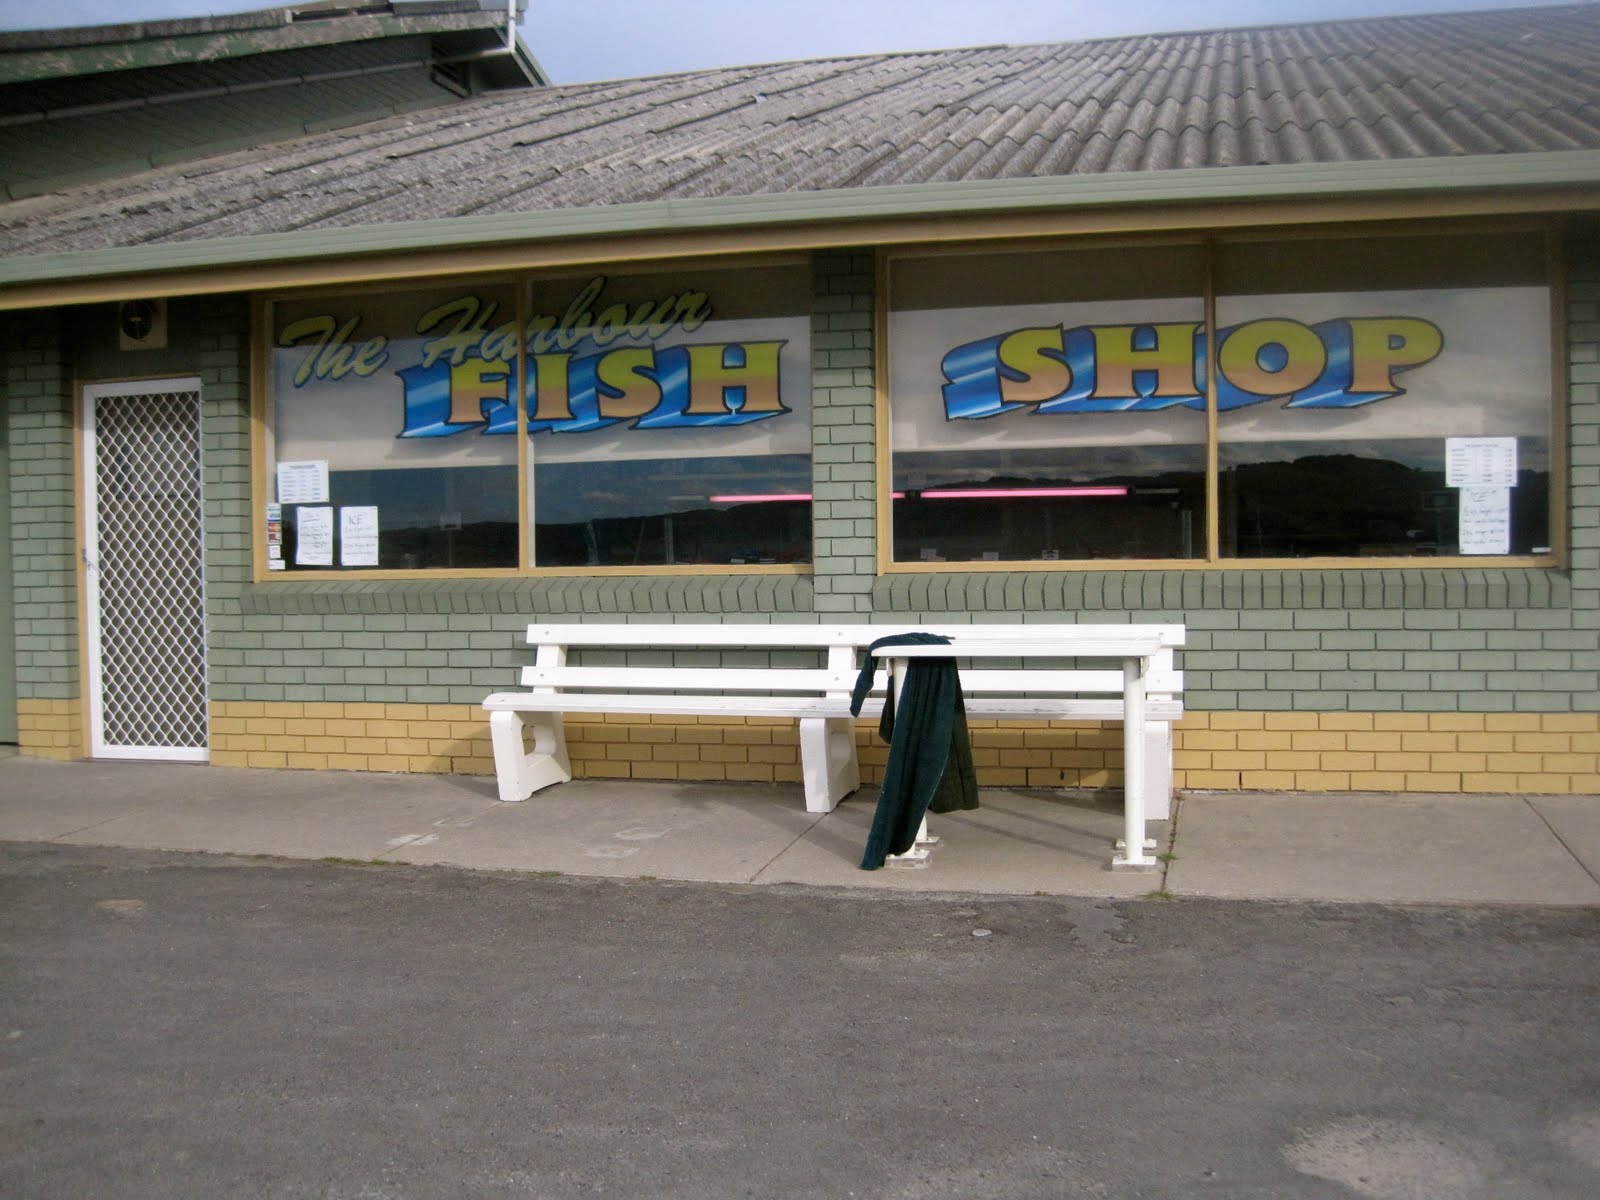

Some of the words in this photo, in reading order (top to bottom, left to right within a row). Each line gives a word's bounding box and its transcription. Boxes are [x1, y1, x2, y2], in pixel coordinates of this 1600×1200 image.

[279, 314, 389, 388] The
[415, 278, 712, 368] Harbour
[945, 317, 1445, 420] SHOP
[400, 339, 793, 436] FISH
